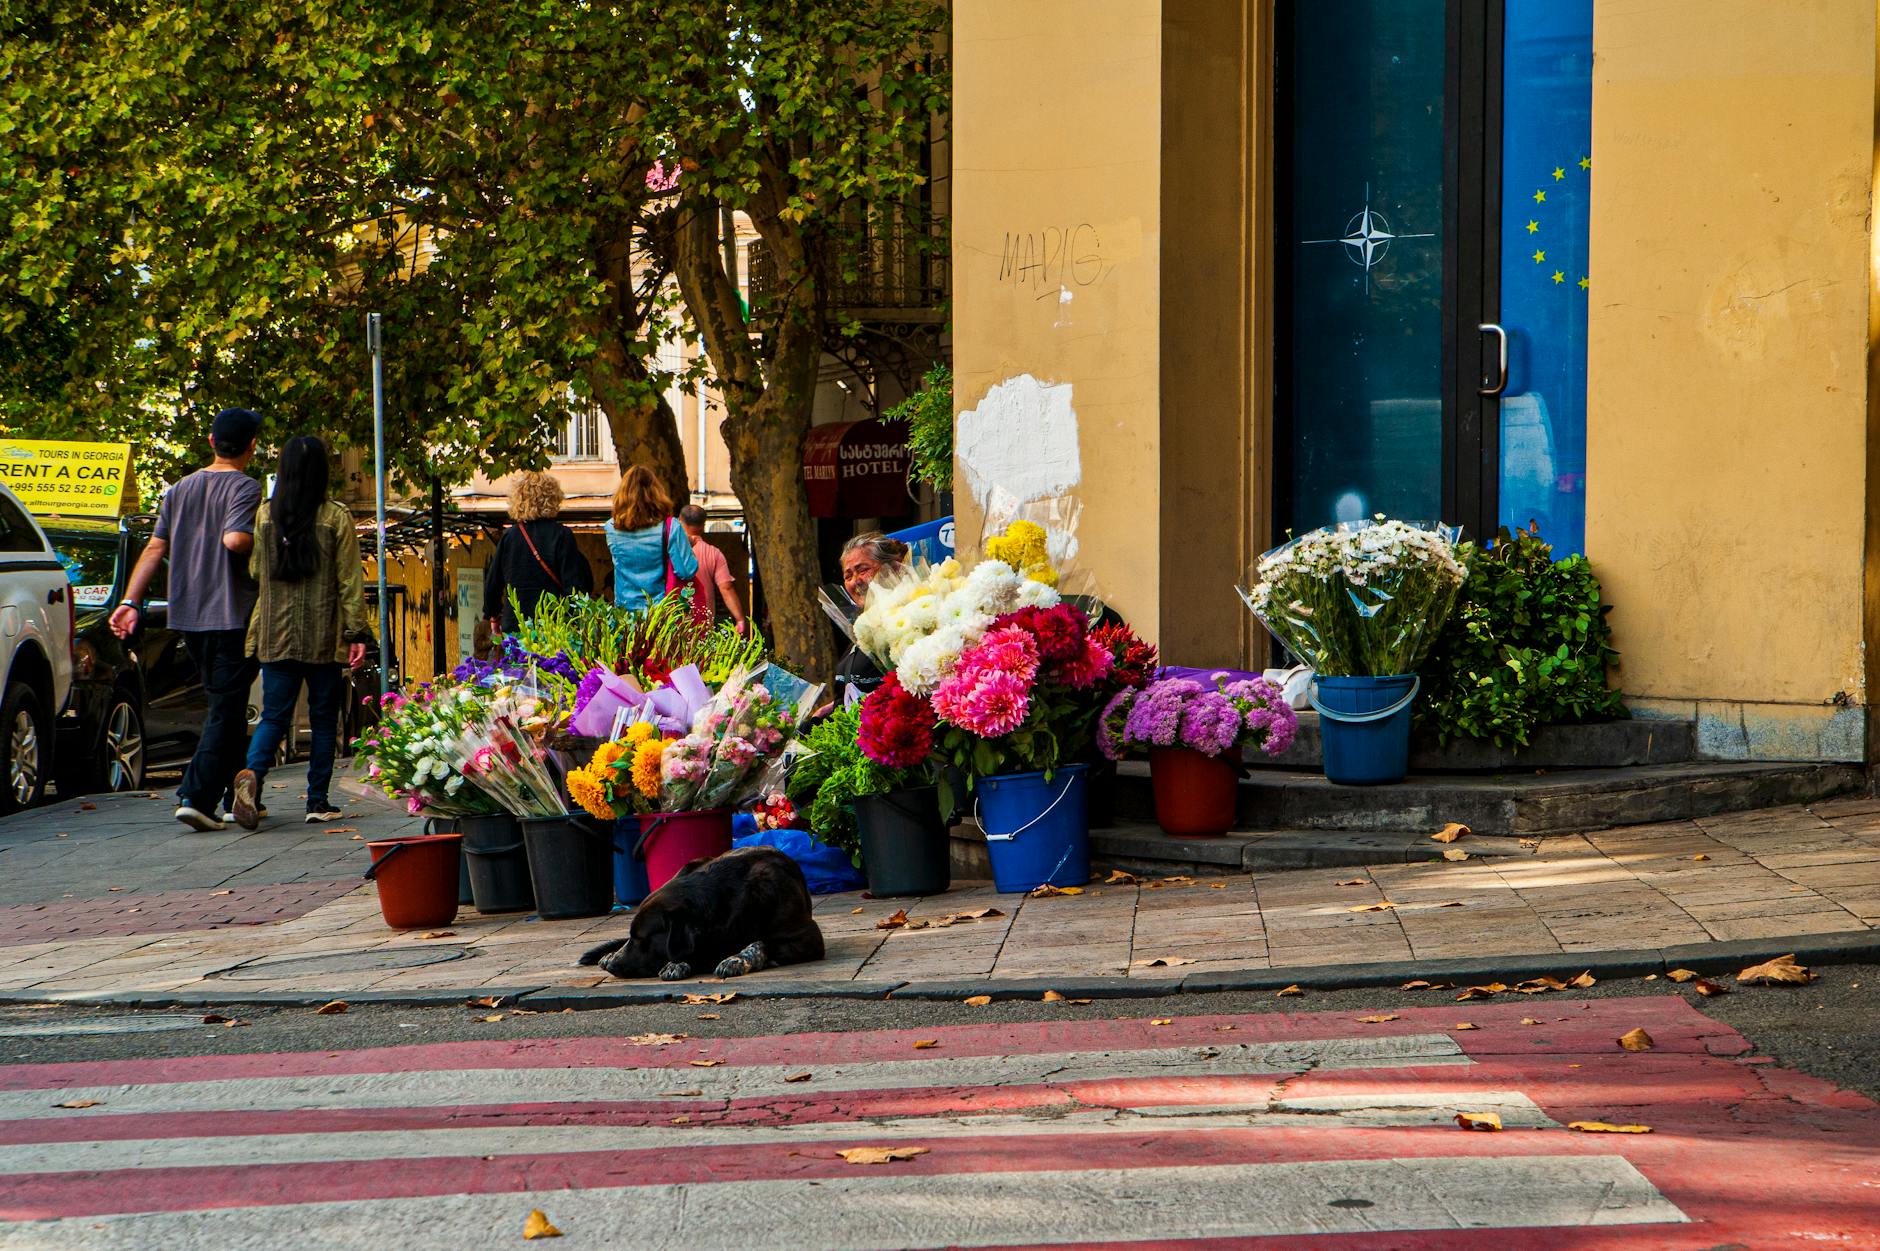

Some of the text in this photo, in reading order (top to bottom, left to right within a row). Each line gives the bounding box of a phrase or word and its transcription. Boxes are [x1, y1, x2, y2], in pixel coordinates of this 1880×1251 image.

[39, 450, 124, 460] TOURS IN GEORGIA
[0, 463, 120, 480] RENT A CAR
[803, 466, 813, 480] TEL
[842, 461, 903, 478] HOTEL
[9, 482, 102, 494] +995 555 52 52 26
[23, 500, 109, 509] .alltourgeorgia.com
[84, 587, 109, 595] CAR
